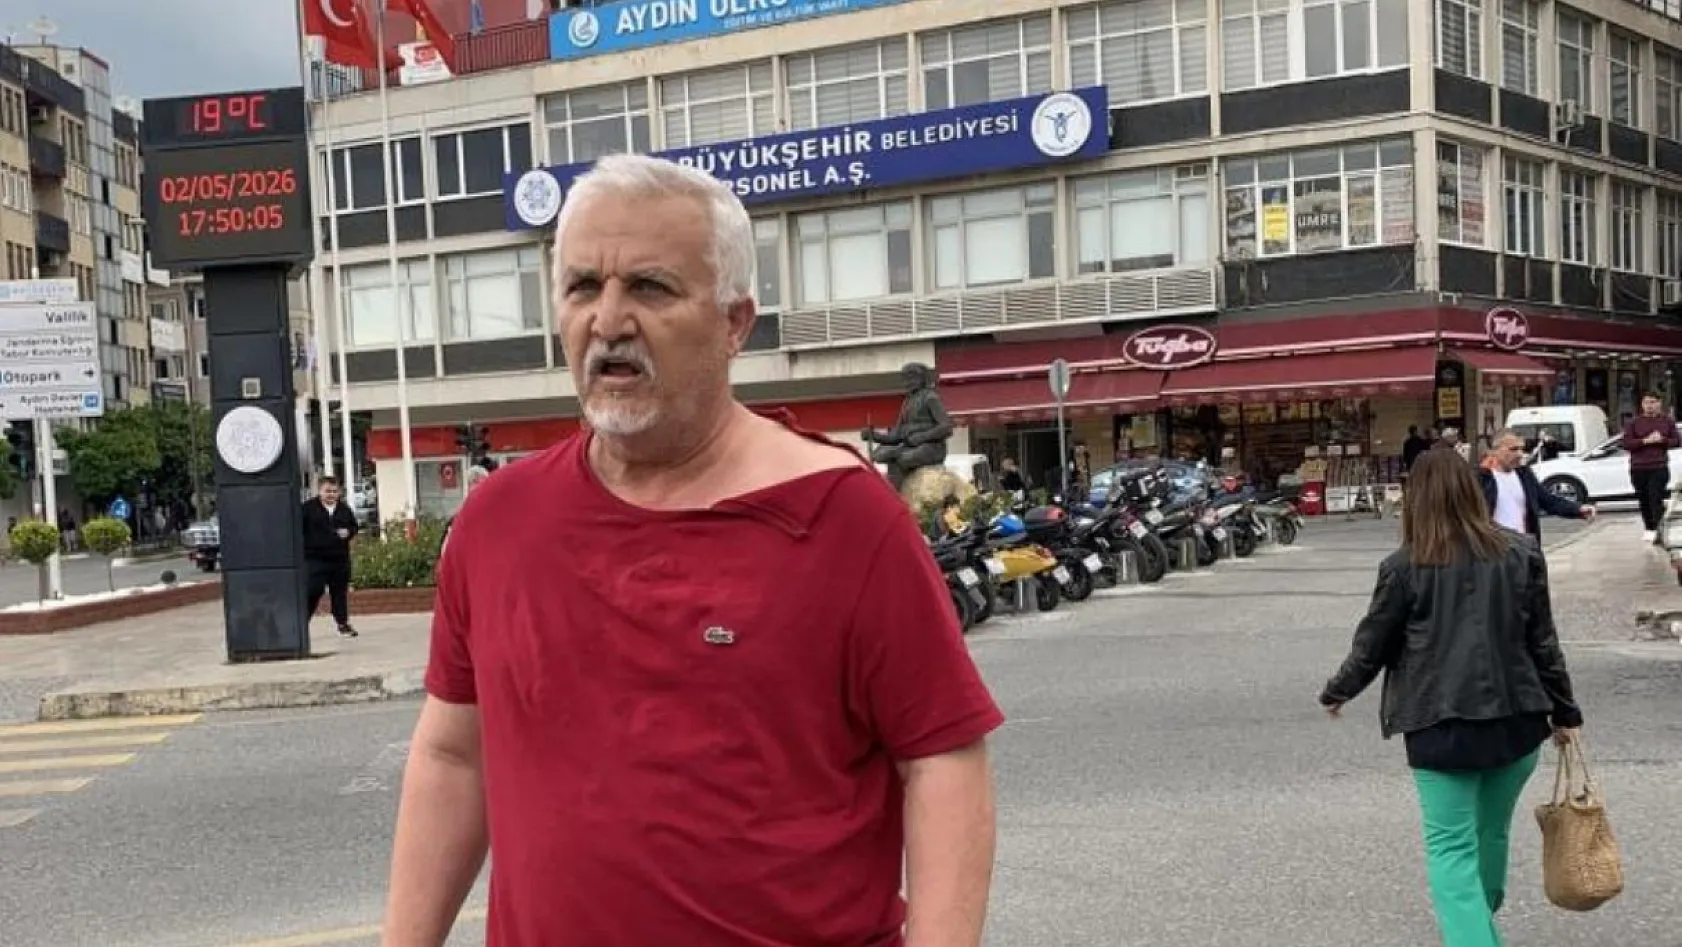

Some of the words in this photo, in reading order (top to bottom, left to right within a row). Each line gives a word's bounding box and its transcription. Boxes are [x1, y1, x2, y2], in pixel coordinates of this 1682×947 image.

[615, 0, 699, 35] AYDIN
[880, 108, 1019, 151] BELEDİYESİ
[160, 169, 297, 203] 02/05/2026
[823, 161, 872, 187] A.Ş.
[179, 204, 283, 236] 17:50:05
[45, 310, 88, 324] Valilik
[4, 371, 61, 386] Otopark
